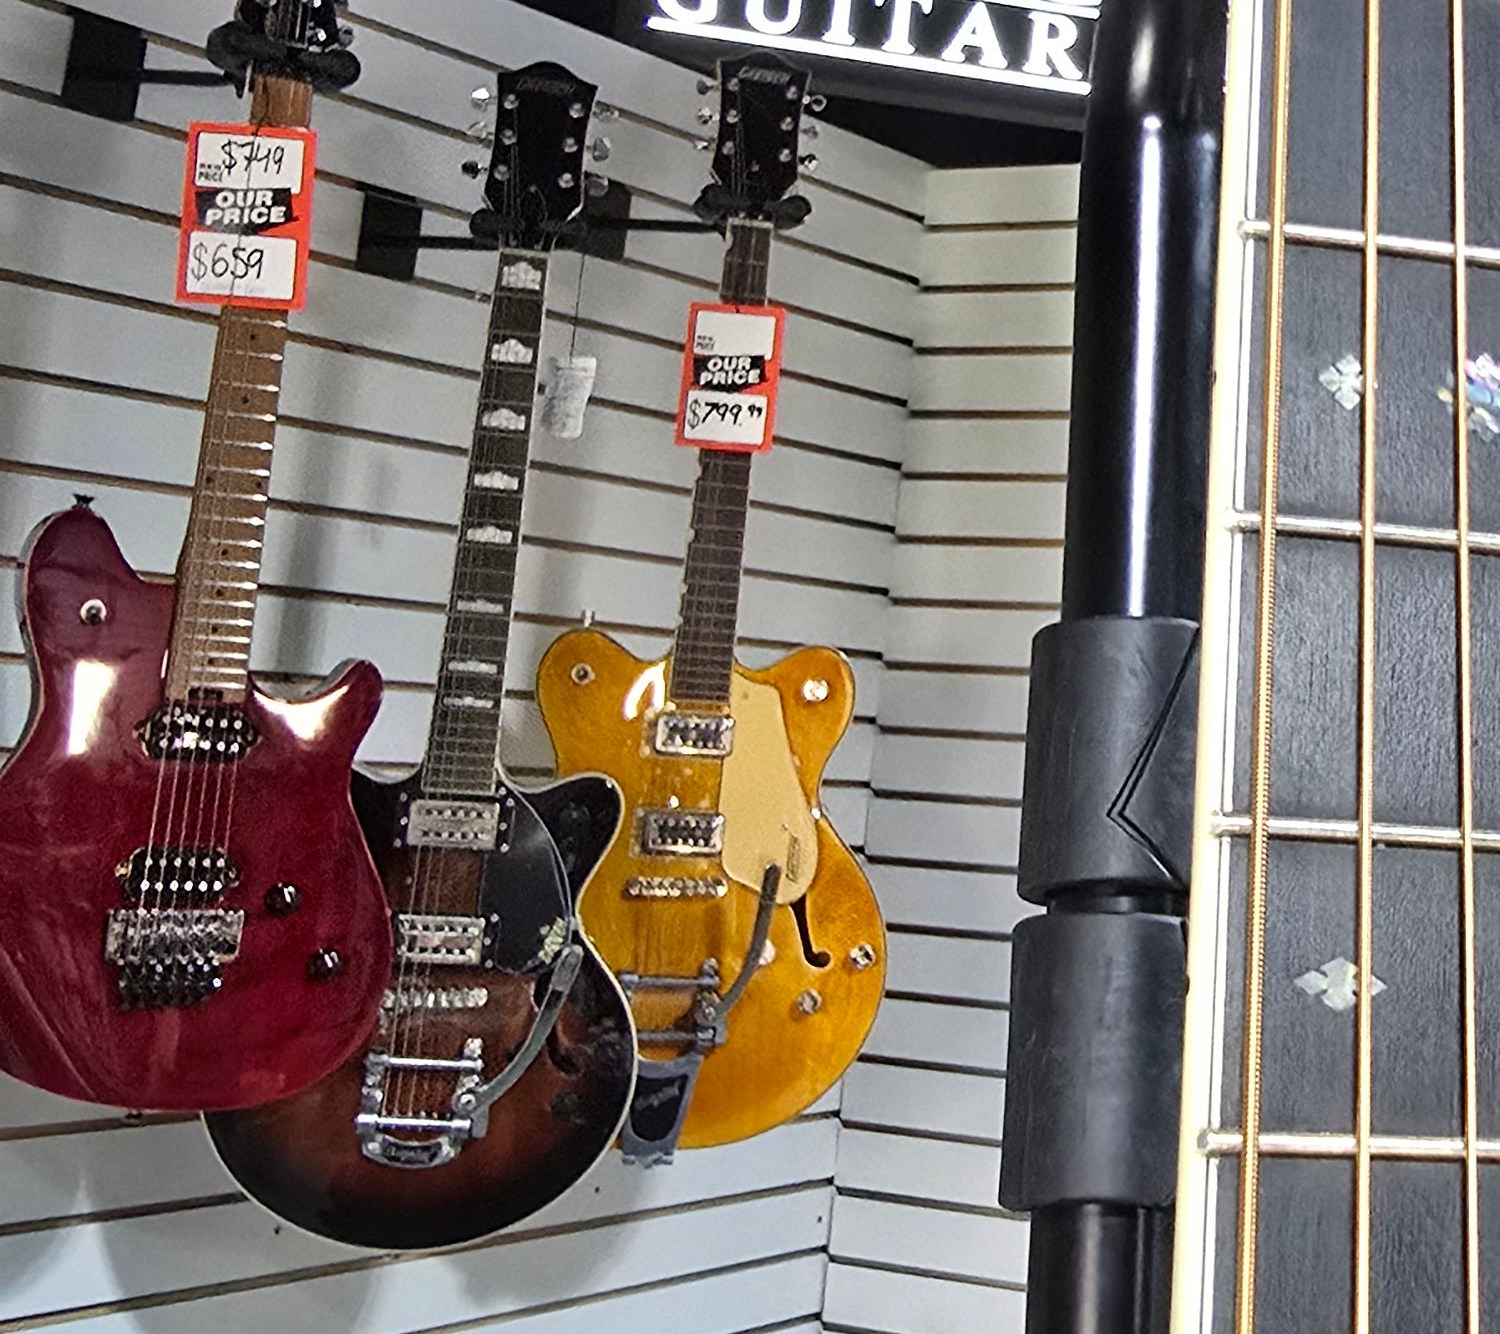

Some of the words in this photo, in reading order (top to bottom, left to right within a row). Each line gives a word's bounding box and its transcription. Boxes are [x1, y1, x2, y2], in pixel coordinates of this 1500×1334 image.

[216, 189, 274, 208] OUR
[205, 206, 288, 226] PRICE
[191, 242, 264, 281] $659
[707, 356, 752, 372] OUR
[700, 369, 761, 386] PRICE
